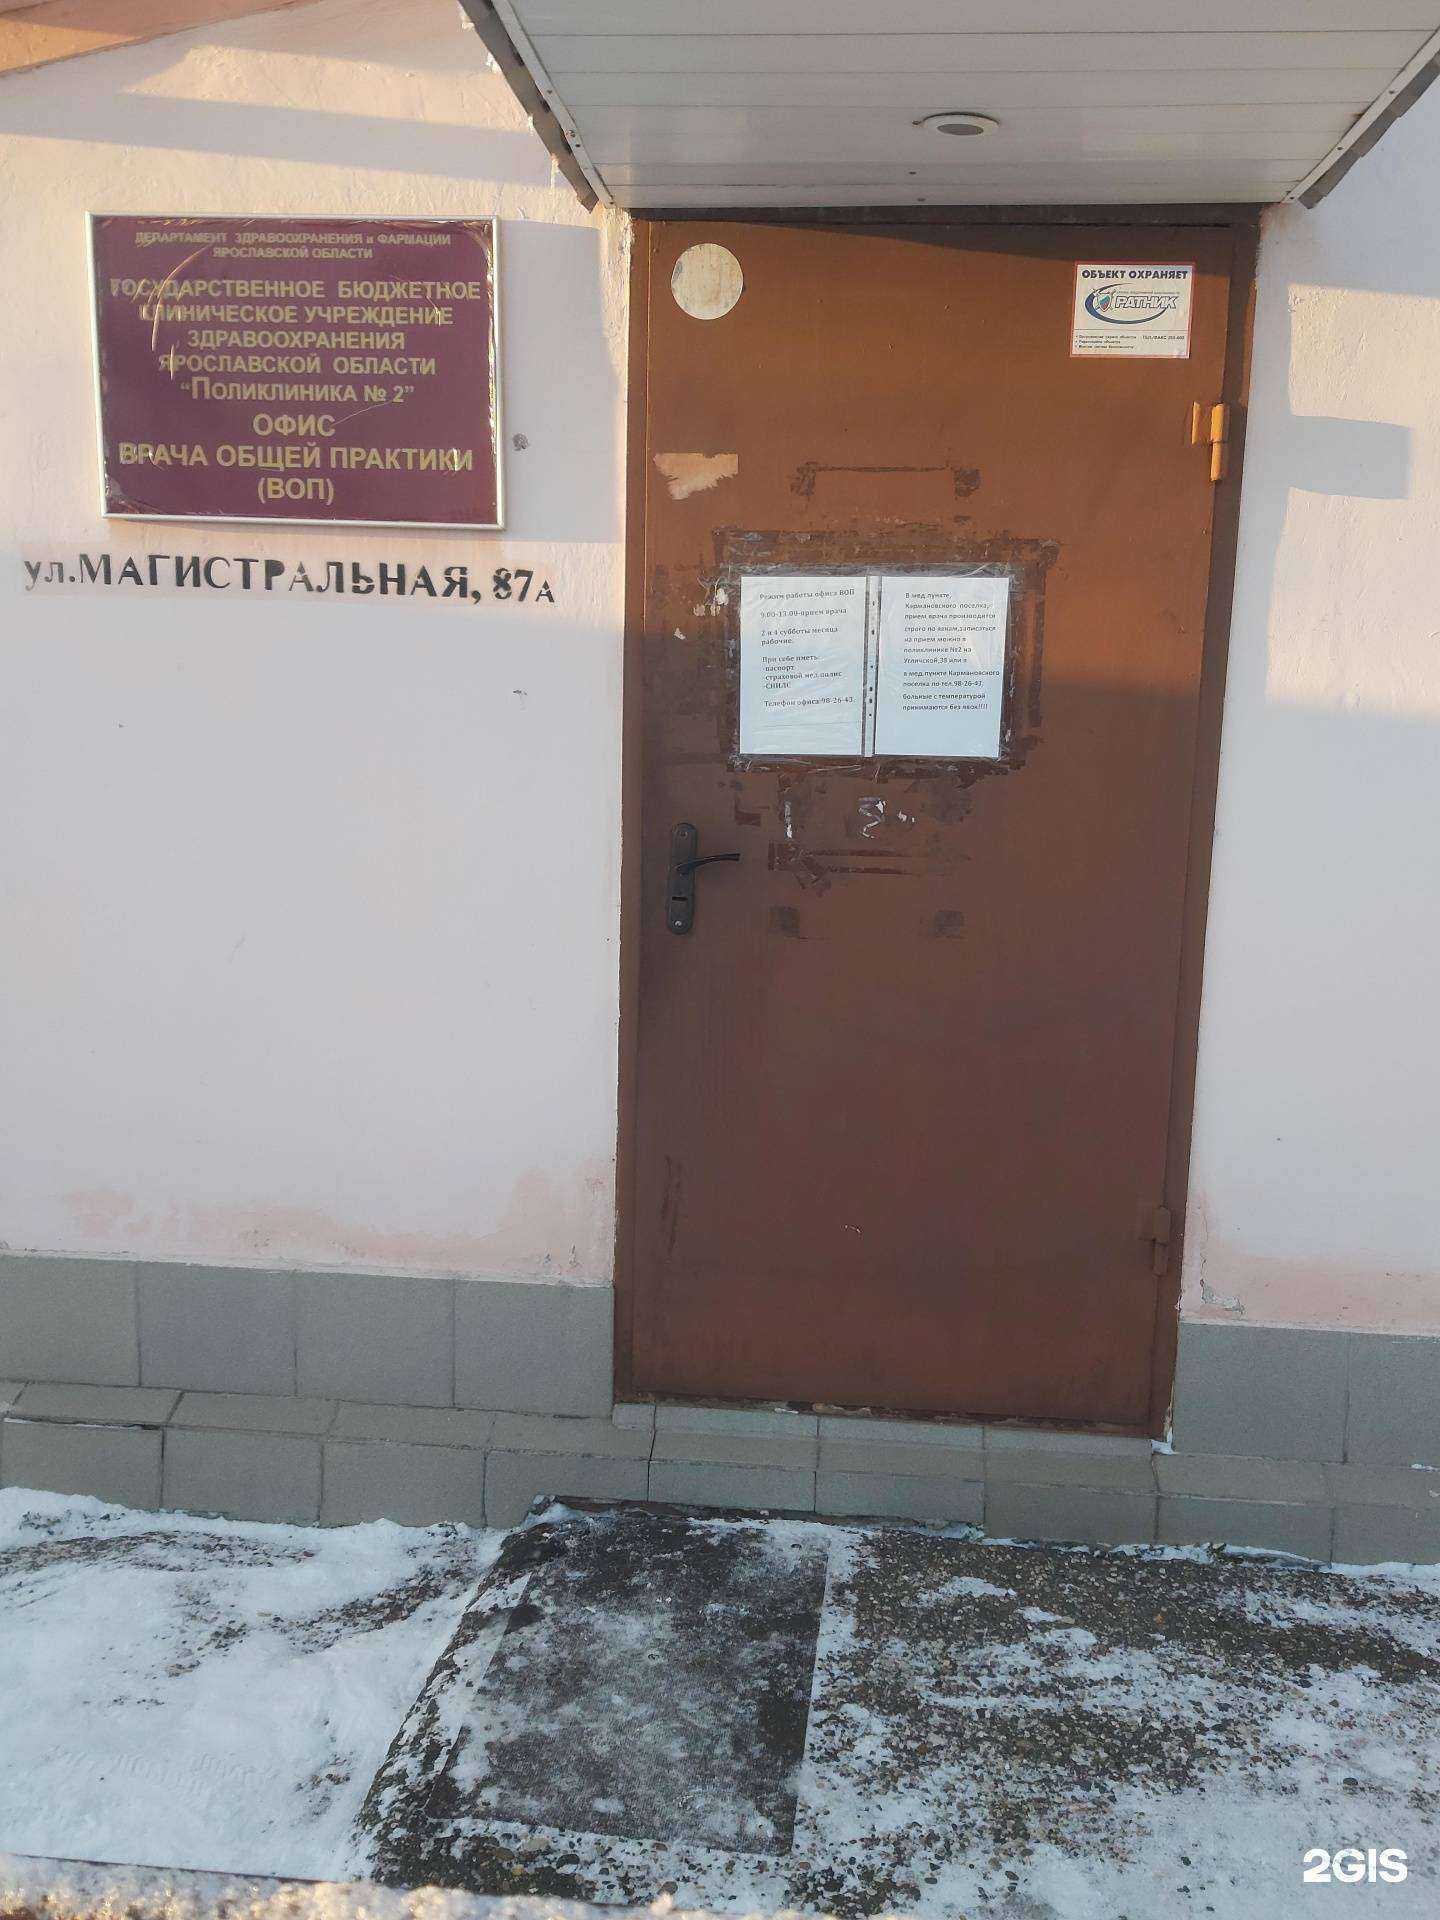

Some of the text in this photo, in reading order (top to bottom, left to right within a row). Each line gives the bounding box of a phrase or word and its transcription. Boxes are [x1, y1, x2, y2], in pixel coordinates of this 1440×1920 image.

[135, 232, 227, 244] ДЕПАРТАМЕНТ
[234, 232, 363, 245] ЗДРАВООХРАНЕНИЯ
[377, 233, 451, 246] ФАРМАЦИИ
[213, 246, 373, 259] ЯРОСЛАВСКОЙ ОБЛАСТИ
[1081, 269, 1188, 280] ОБЪЕКТ ОХРАНЯЕТ
[110, 278, 481, 301] ГОСУДАРСТВЕННОЕ БЮДЖЕТНОЕ
[1115, 295, 1179, 310] РАТНИК
[304, 306, 454, 327] УЧРЕЖДЕНИЕ
[187, 330, 405, 350] ЗДРАВООХРАНЕНИЯ
[159, 353, 436, 376] ЯРОСЛАВСКОЙ ОБЛАСТИ
[253, 414, 336, 438] ОФИС
[119, 442, 473, 472] ВРАЧА ОБЩЕЙ ПРАКТИКИ
[258, 478, 335, 506] (ВОП)
[839, 588, 855, 596] ВОП
[780, 627, 811, 637] субботы
